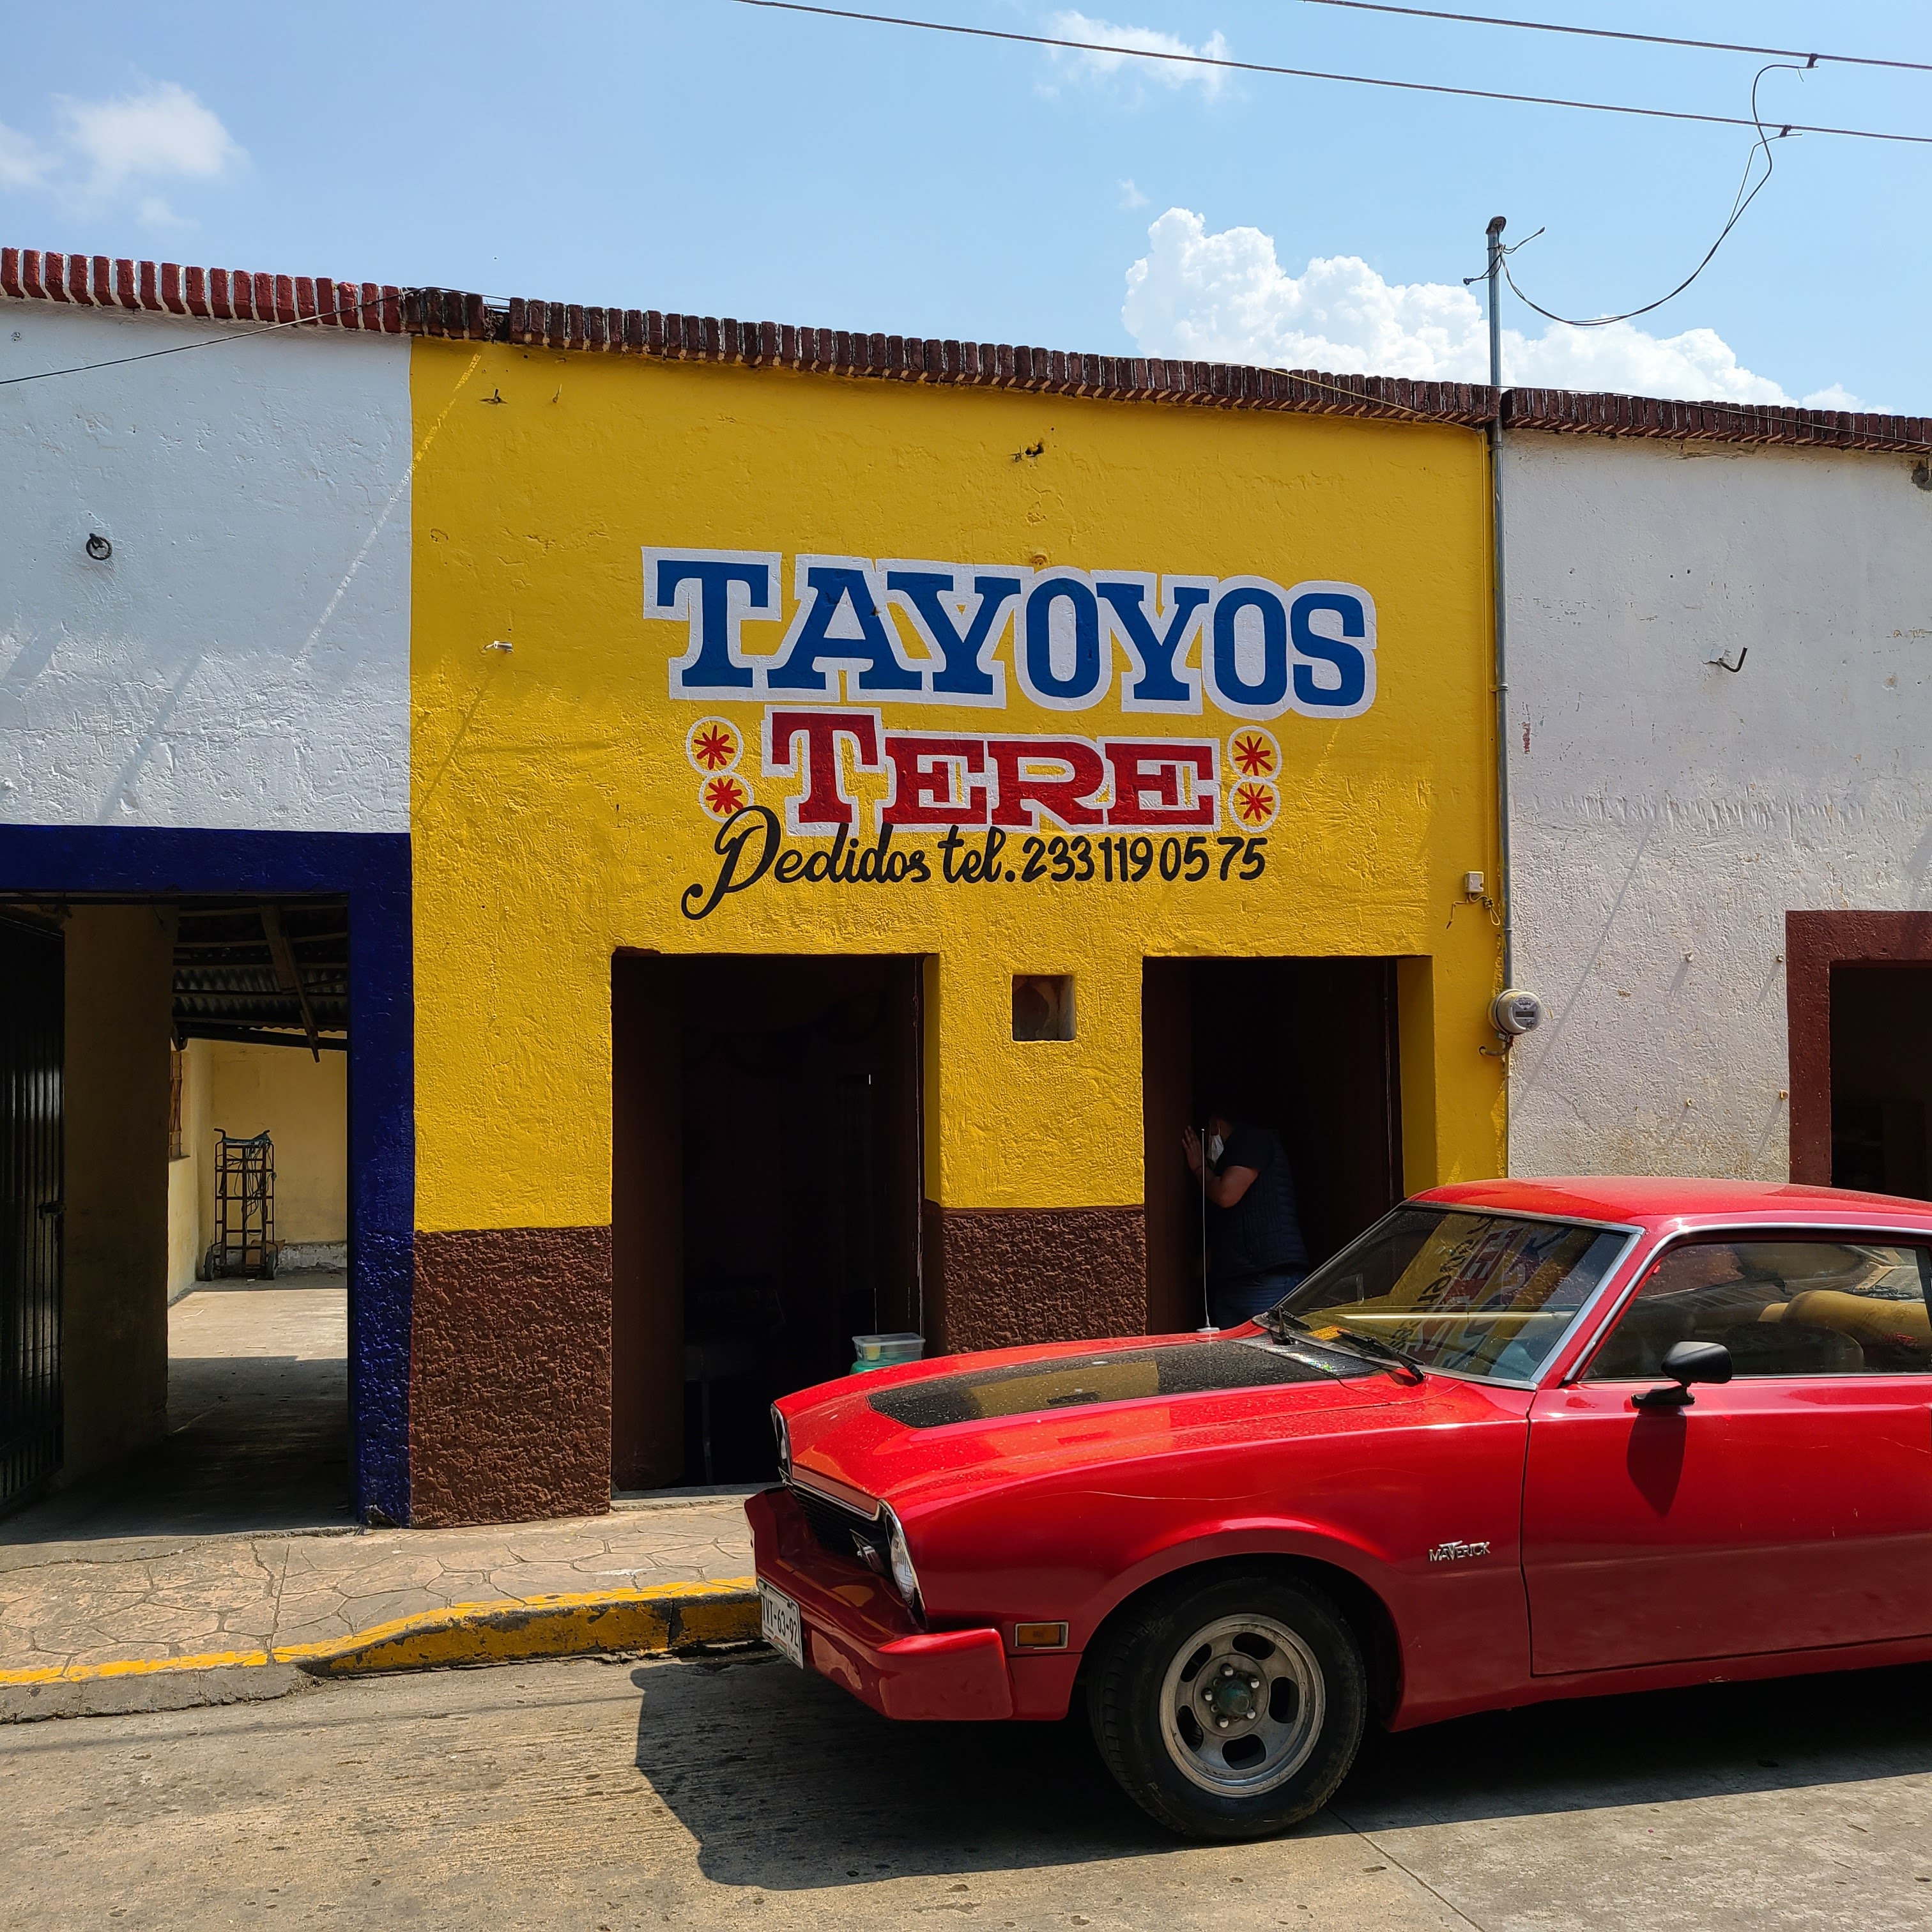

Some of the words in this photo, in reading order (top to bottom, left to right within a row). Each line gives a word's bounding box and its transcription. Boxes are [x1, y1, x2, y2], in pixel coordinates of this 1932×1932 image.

[656, 560, 1366, 707] TAYOYOS
[772, 712, 1215, 826] TERE
[681, 805, 931, 920] Pedidos
[1429, 1540, 1491, 1561] MAVERICK
